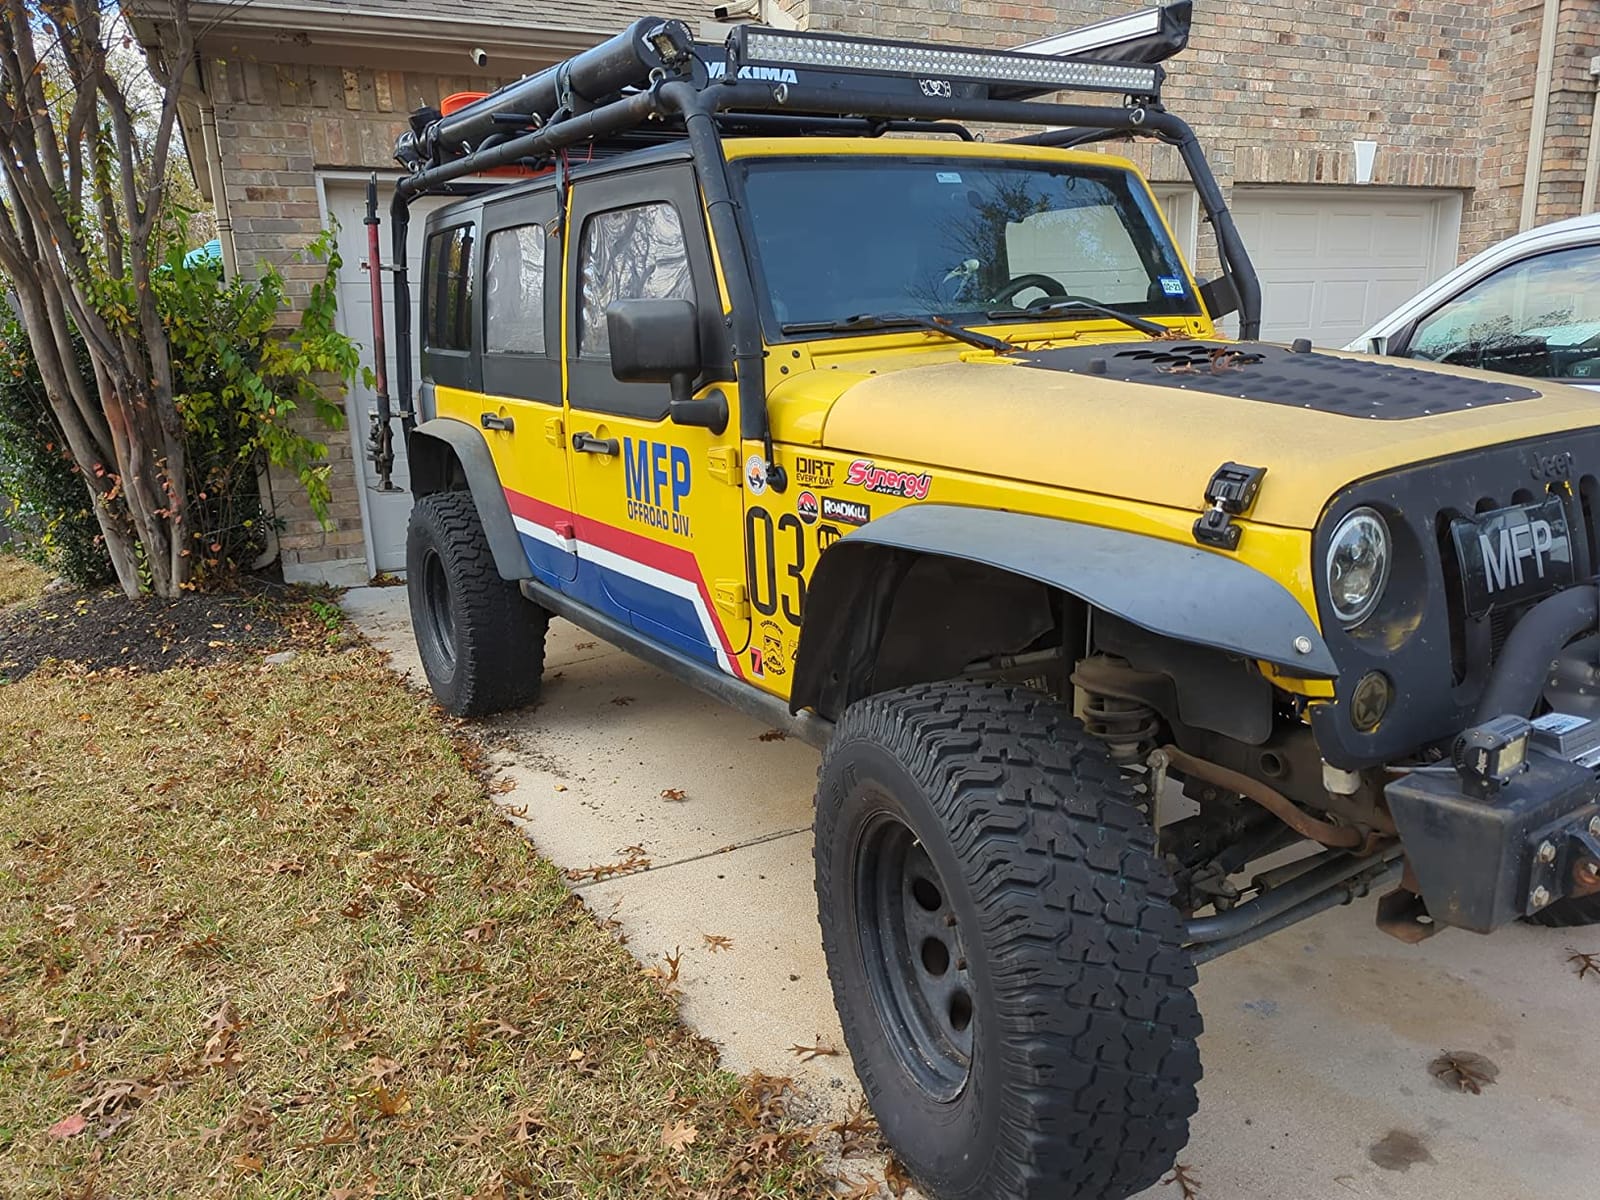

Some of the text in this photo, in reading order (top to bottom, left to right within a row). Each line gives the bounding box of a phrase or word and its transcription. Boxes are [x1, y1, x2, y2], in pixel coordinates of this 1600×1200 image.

[623, 436, 692, 513] MFP
[796, 457, 835, 477] DIRT
[796, 473, 834, 487] EVERY DAY
[845, 459, 932, 500] Synergy
[1530, 451, 1573, 481] Jeep
[876, 486, 901, 496] MFG
[627, 500, 694, 538] OFFROAD DIV.
[746, 506, 806, 627] 03
[1479, 520, 1552, 593] MFP
